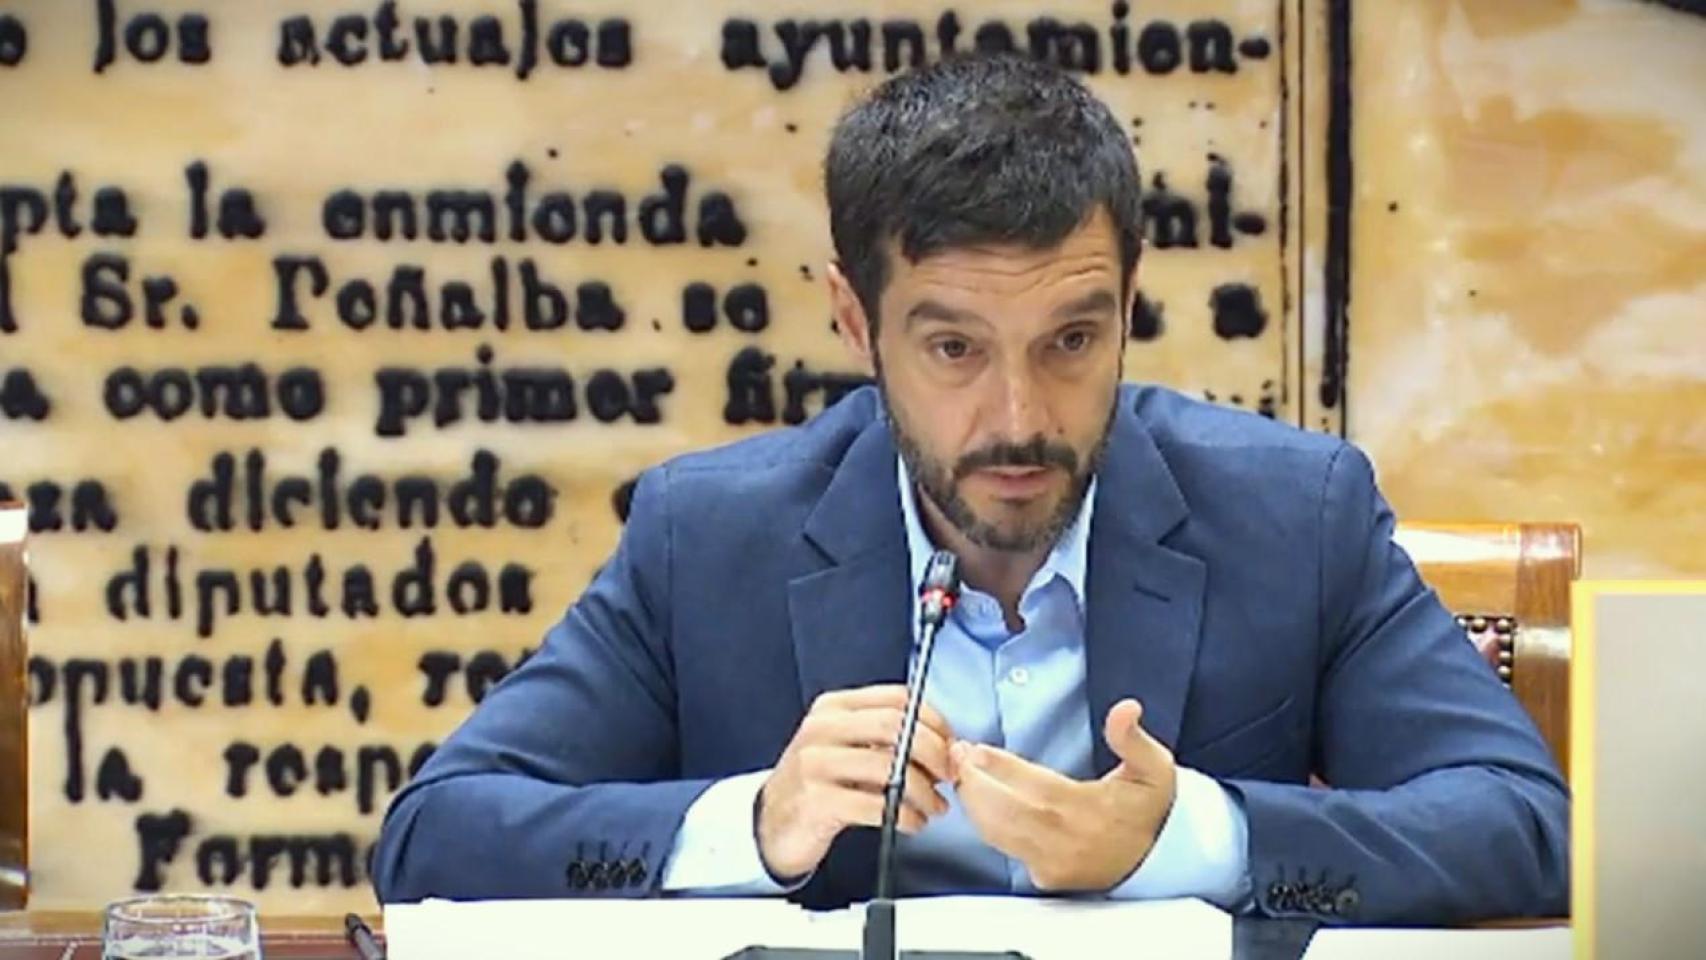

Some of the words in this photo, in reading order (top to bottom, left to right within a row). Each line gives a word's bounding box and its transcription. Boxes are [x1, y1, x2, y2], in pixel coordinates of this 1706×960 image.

[92, 0, 213, 76] los
[276, 0, 634, 82] actuales
[720, 0, 1271, 89] ayuntamien-
[184, 160, 268, 242] la
[80, 252, 201, 333] Sr.
[102, 361, 328, 423] como
[372, 343, 677, 439] primer
[185, 445, 560, 535] diciendo
[104, 534, 536, 640] diputados
[417, 647, 540, 709] re
[133, 809, 382, 891] Form
